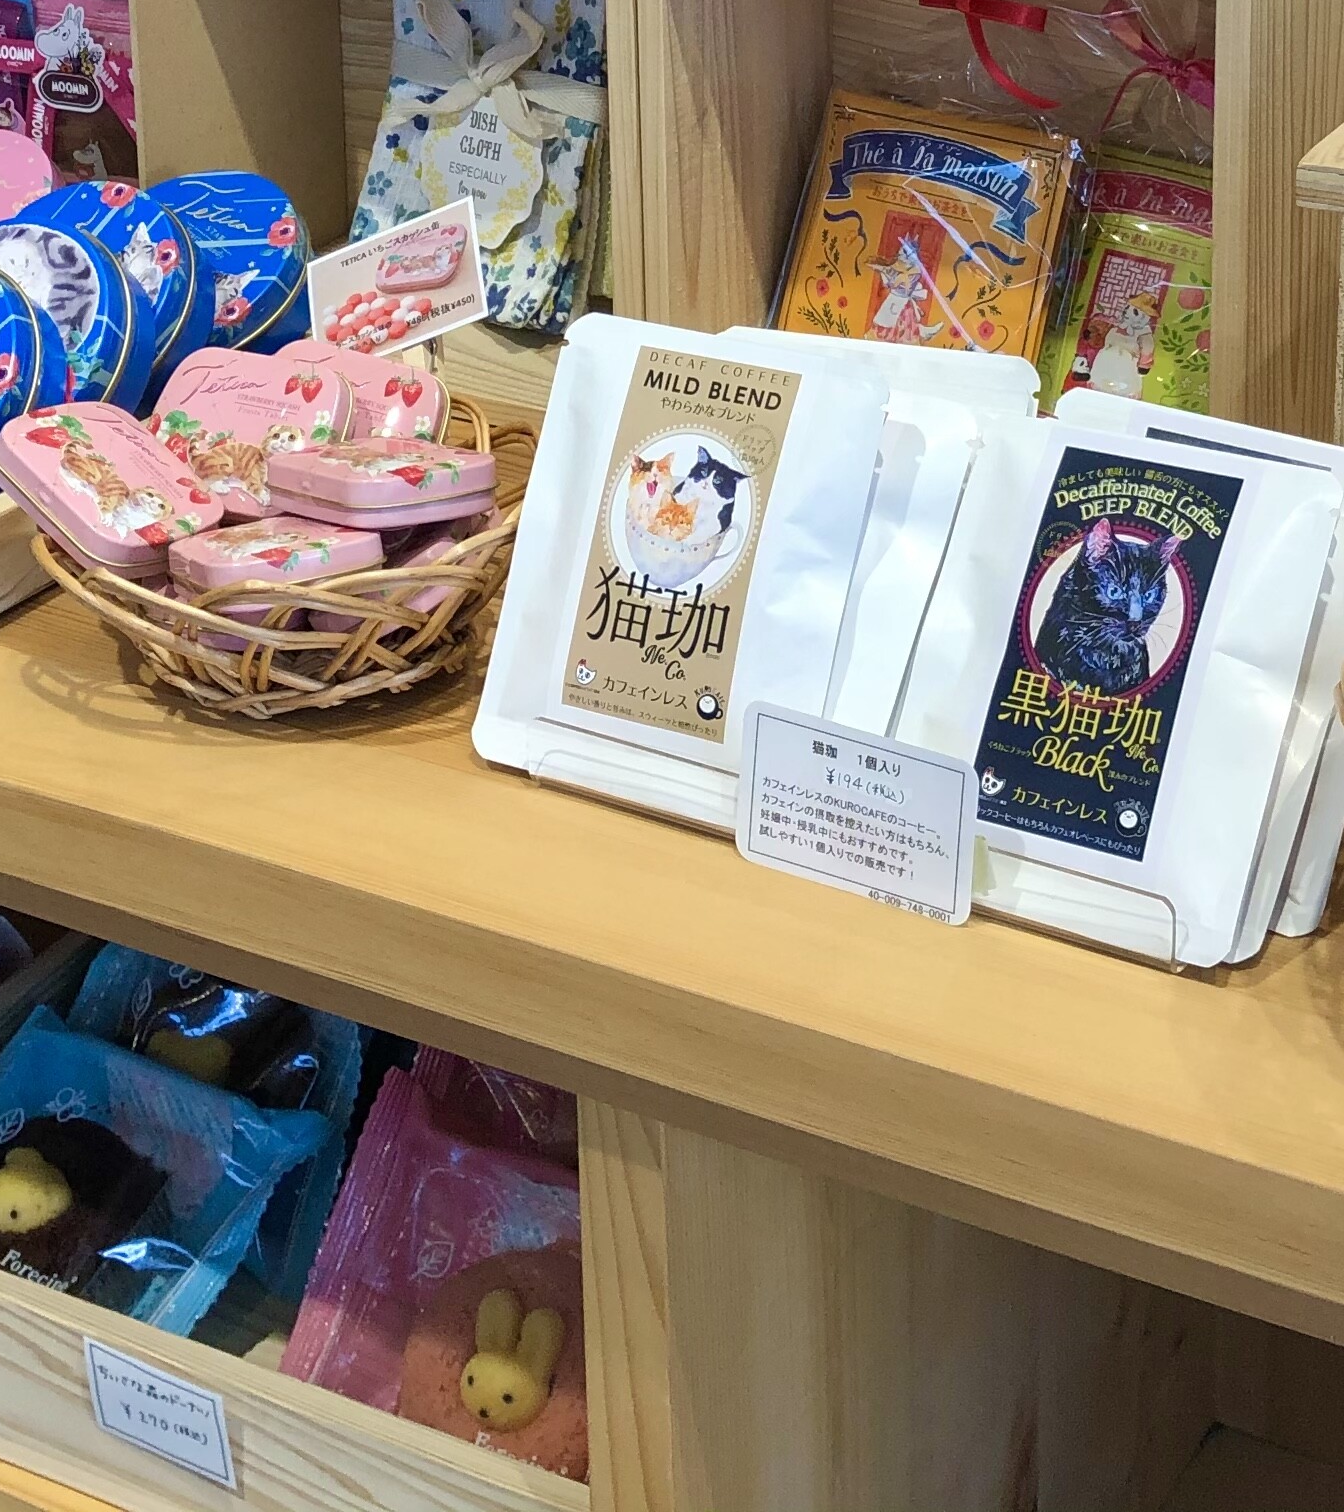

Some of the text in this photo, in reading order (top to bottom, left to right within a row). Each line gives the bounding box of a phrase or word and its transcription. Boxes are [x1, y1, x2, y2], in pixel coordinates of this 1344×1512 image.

[51, 79, 89, 95] MOOMIN
[469, 110, 499, 134] DISH
[459, 134, 502, 162] CLOTH
[848, 139, 1022, 202] Thé à la maison
[448, 161, 507, 186] ESPECIALLY
[457, 180, 488, 202] for you
[170, 180, 265, 234] Tetica
[340, 220, 440, 268] TETICA いちごスカッシュ缶
[180, 358, 268, 406] Tetica
[643, 369, 783, 413] MILD BLEND
[648, 351, 792, 388] DECAF COFFEE
[659, 396, 756, 426] やわらかなブレンド
[1053, 479, 1223, 542] Decaffeinated Coffee
[1079, 497, 1196, 544] DEEP BLEND
[585, 564, 732, 661] 猫珈
[602, 674, 690, 711] カフェインレス
[997, 667, 1163, 751] 黒猫珈
[812, 739, 902, 778] 猫珈 1個入り
[1032, 734, 1116, 794] Black
[761, 792, 950, 860] カフェインの摂取を控えたい方はもちろん、
[762, 775, 942, 841] カフェインレスのKUROCAFEのコーヒー。
[1012, 785, 1109, 826] カフェインレス
[759, 823, 915, 882] 試しやすい1個入りでの販売です！
[760, 808, 914, 866] 妊娠中・授乳中にもおすすめです。
[868, 890, 952, 924] 40-009-748-0001
